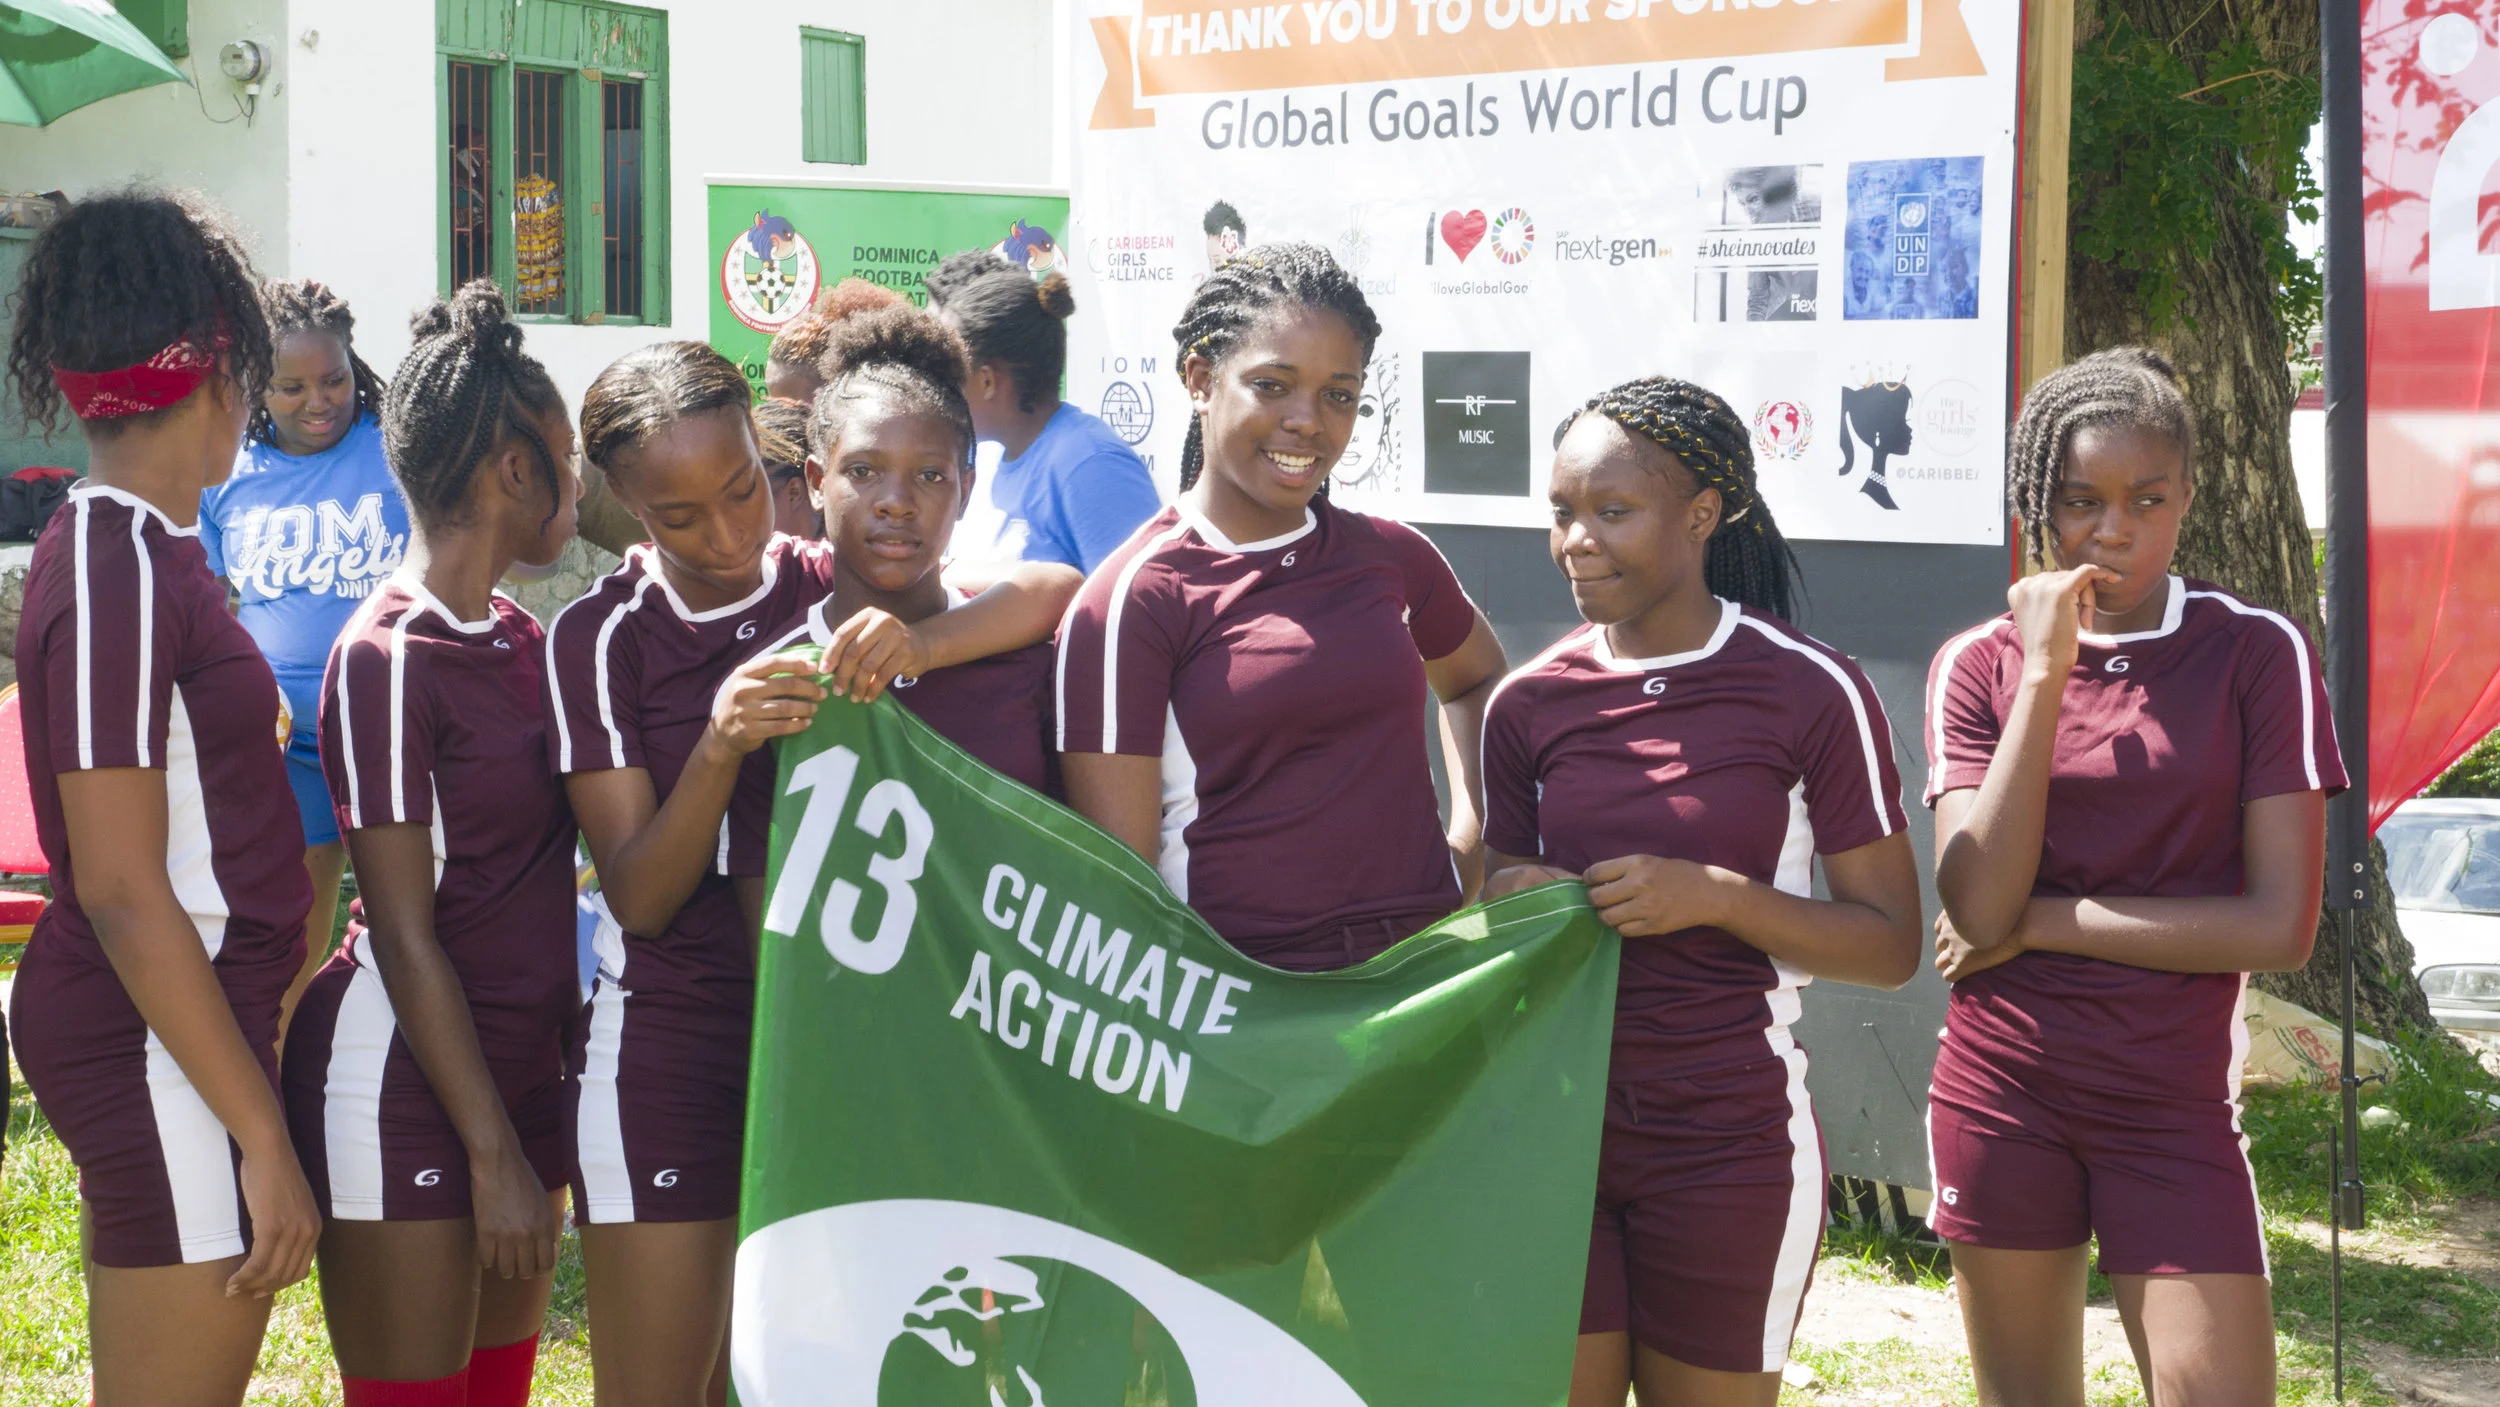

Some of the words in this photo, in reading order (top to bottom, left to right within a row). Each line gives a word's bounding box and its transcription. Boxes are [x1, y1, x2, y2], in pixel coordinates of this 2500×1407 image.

[1147, 5, 1291, 56] THANK
[1301, 0, 1397, 45] YOU
[1410, 0, 1472, 36] TO
[1202, 91, 1348, 150] Global
[1368, 82, 1499, 142] Goals
[1520, 68, 1678, 134] World
[1701, 65, 1807, 136] Cup
[852, 246, 940, 265] DOMINICA
[1107, 236, 1174, 250] CARIBBEAN
[1556, 234, 1656, 266] next-gen
[1697, 237, 1816, 258] #sheinnovates
[1107, 252, 1147, 267] GIRLS
[1108, 267, 1174, 281] ALLIANCE
[1465, 395, 1487, 416] RF
[1458, 429, 1495, 445] MUSIC
[239, 493, 391, 563] IOM
[229, 525, 404, 599] Angels
[334, 572, 393, 599] UNIT
[764, 744, 934, 975] 13
[982, 863, 1252, 1036] CLIMATE
[949, 950, 1192, 1113] ACTION
